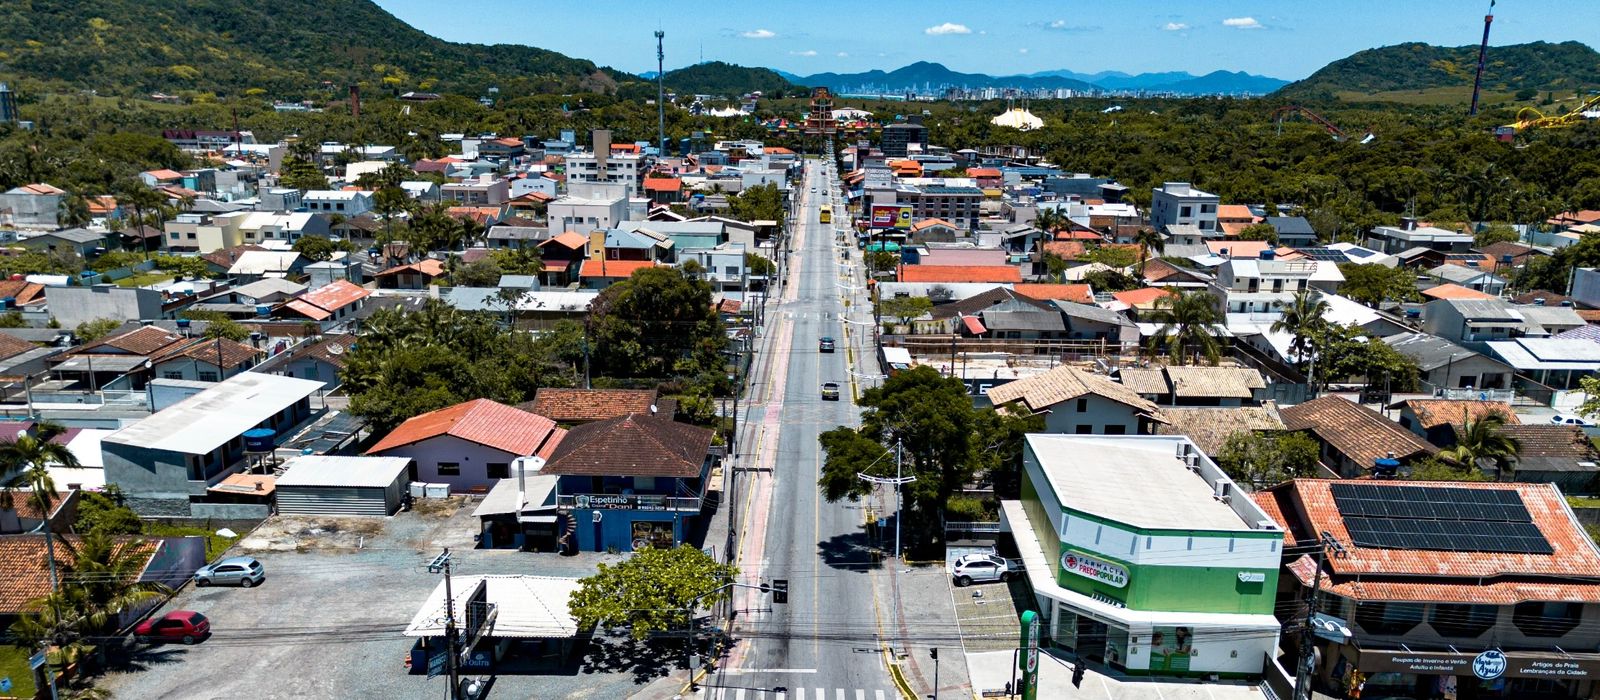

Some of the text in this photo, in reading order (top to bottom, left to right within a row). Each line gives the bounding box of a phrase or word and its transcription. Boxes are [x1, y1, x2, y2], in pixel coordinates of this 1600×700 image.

[590, 496, 628, 504] Espetinho
[1080, 557, 1124, 576] FARMACIA
[1478, 661, 1501, 676] Azul
